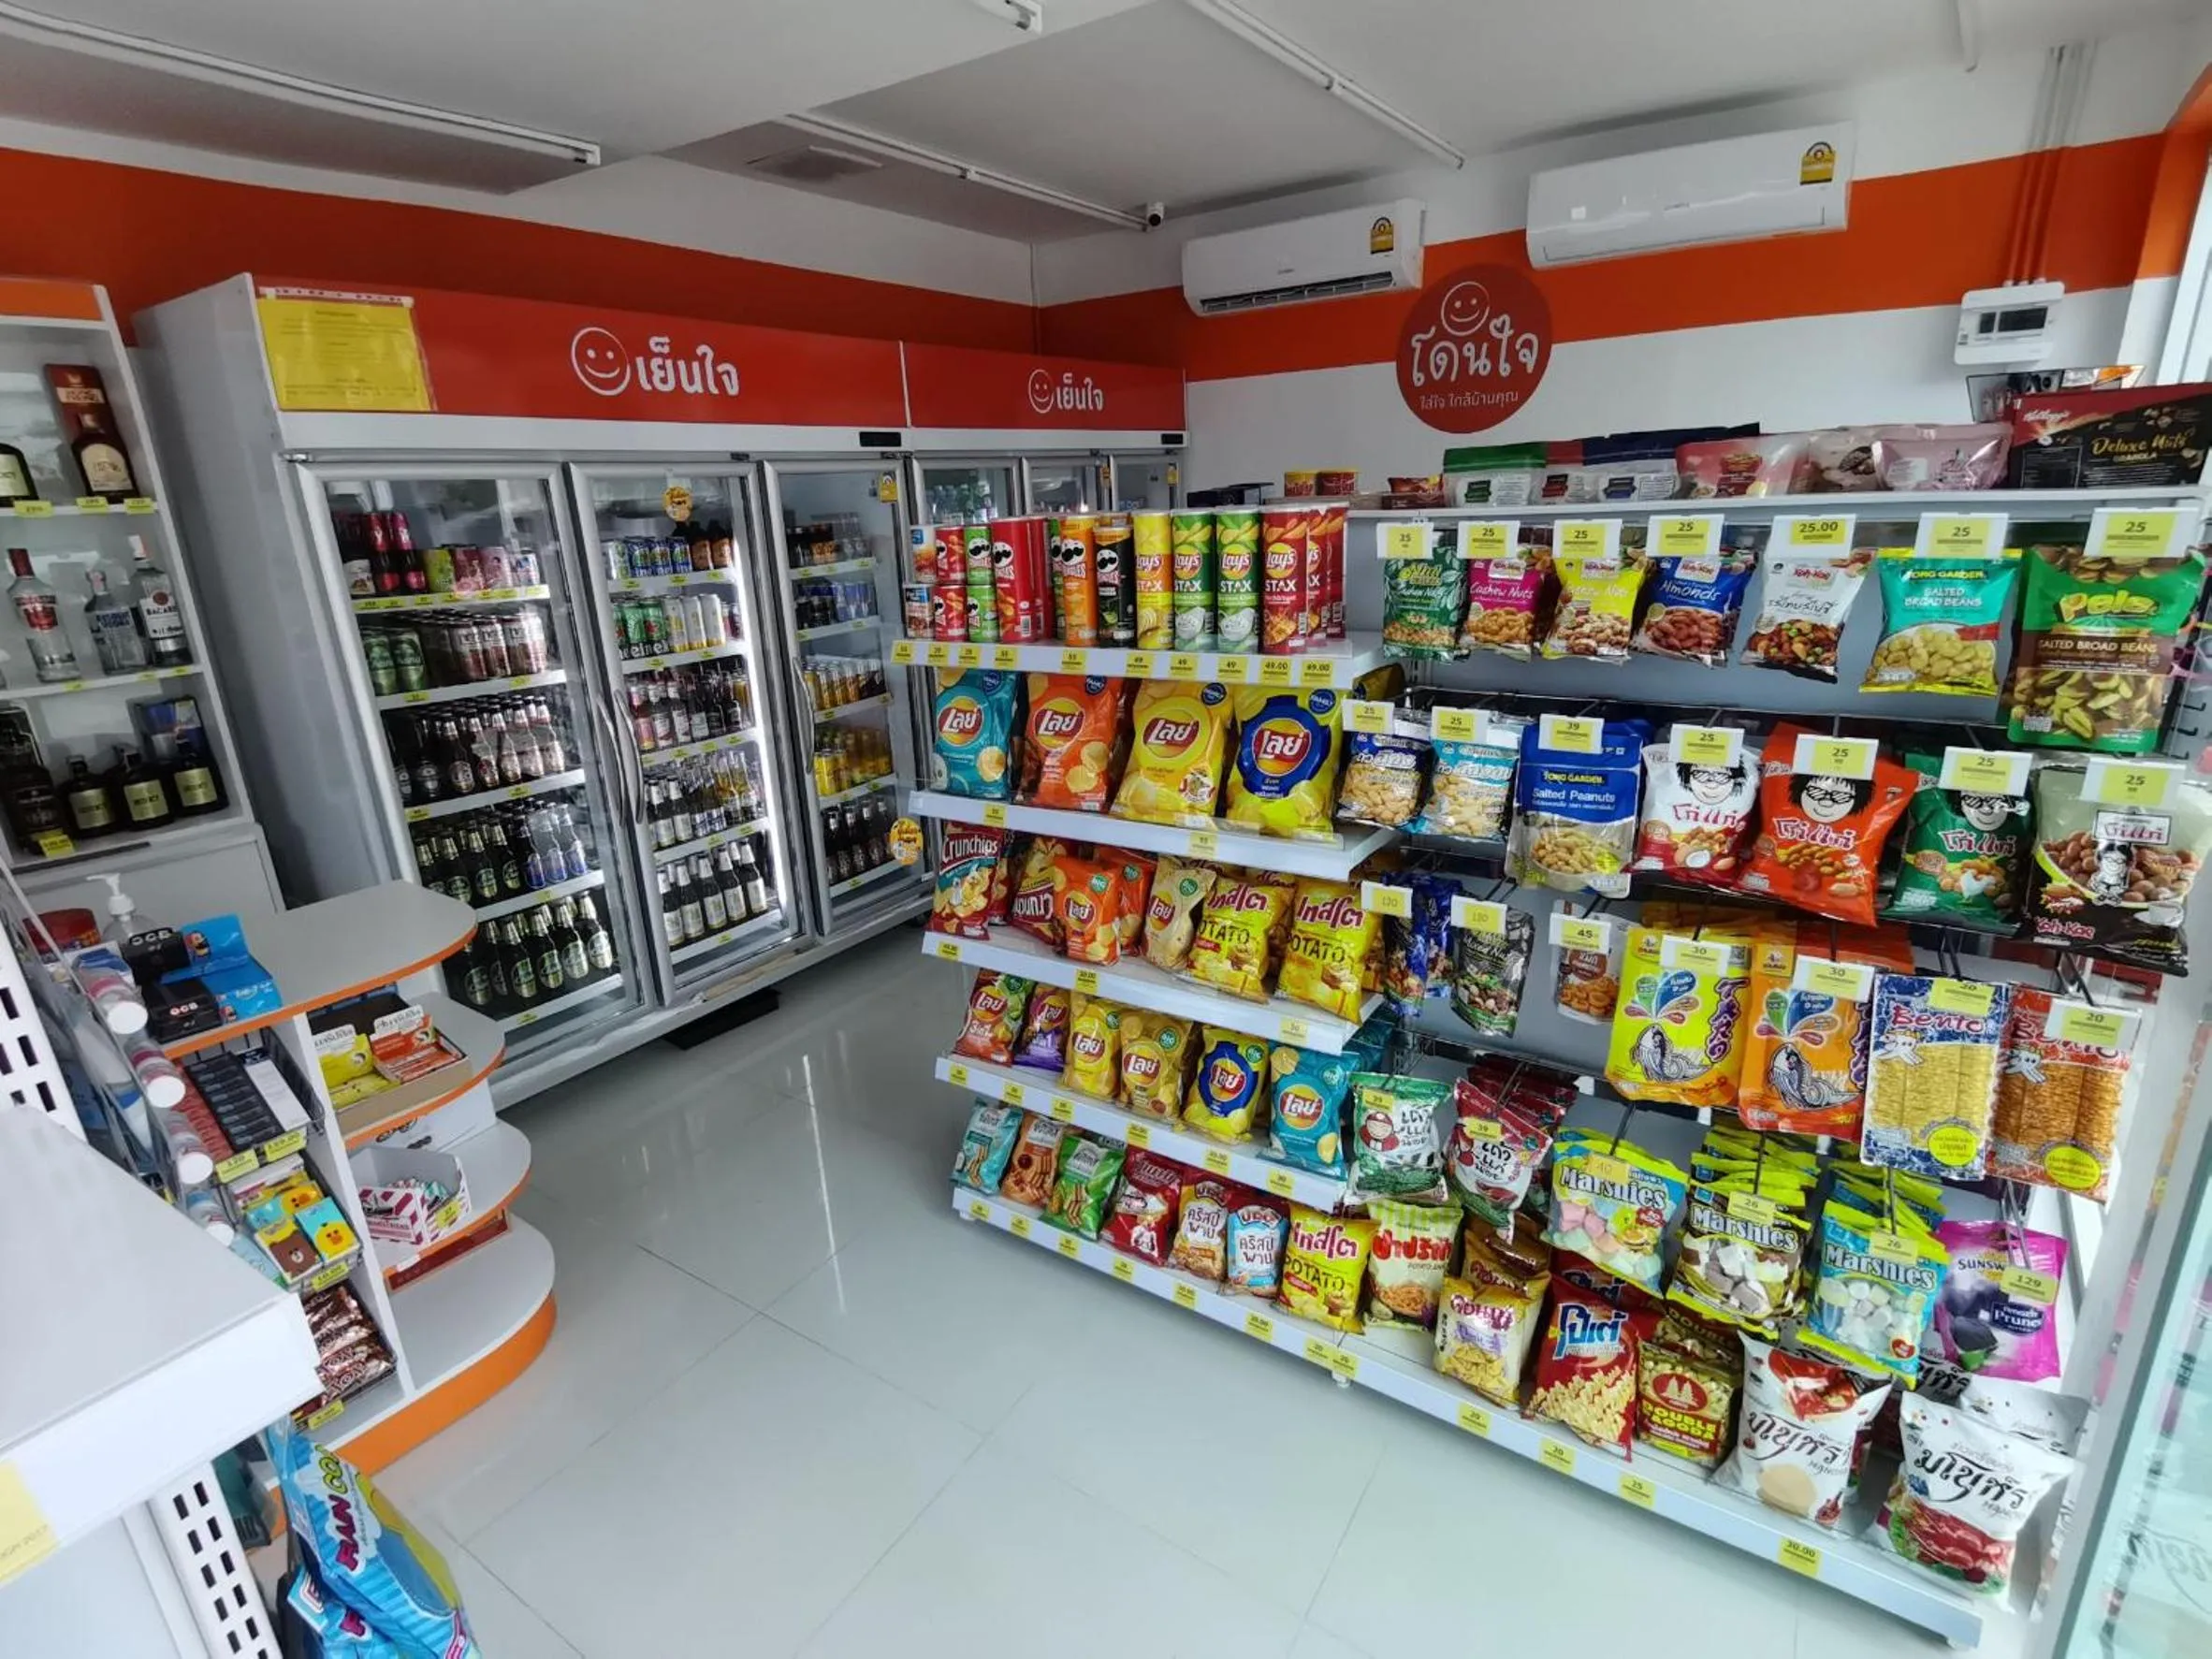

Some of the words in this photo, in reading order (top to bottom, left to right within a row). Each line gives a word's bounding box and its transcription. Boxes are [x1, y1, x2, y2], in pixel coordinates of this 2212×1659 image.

[1411, 313, 1539, 387] โดนใจ
[636, 336, 739, 396] เย็นใจ
[1055, 371, 1103, 411] เย็นใจ
[2090, 435, 2147, 456] Deluxe
[1482, 528, 1495, 537] 25
[1678, 521, 1694, 531] 25
[1798, 521, 1839, 533] 25.00
[1952, 527, 1971, 537] 25
[2124, 521, 2147, 533] 25
[1574, 531, 1588, 539] 25
[1220, 579, 1252, 591] STAX
[1265, 579, 1297, 591] STAX
[1469, 582, 1506, 598] Cashew
[1508, 587, 1534, 600] Nuts
[1661, 579, 1722, 601] Almonds
[1924, 588, 1965, 597] SALTED
[1904, 598, 1943, 607] BROAD
[1944, 598, 1983, 607] BEANS
[2076, 640, 2118, 651] BROAD
[2120, 641, 2158, 653] BEANS
[942, 706, 979, 733] เลย์
[1039, 707, 1080, 735] เลย์
[1146, 719, 1196, 746] เลย์
[1699, 732, 1714, 743] 25
[1259, 728, 1306, 759] เลย์
[1832, 747, 1848, 758] 25
[1976, 756, 1995, 767] 25
[2125, 774, 2146, 786] 25
[1533, 787, 1565, 801] Salted
[1569, 789, 1616, 804] Peanuts
[941, 834, 998, 864] Crunchips
[1198, 921, 1251, 945] OTATO
[1577, 928, 1594, 939] 45
[1289, 934, 1346, 963] OTATO
[1692, 947, 1708, 956] 30
[1828, 967, 1845, 977] 30
[170, 1001, 199, 1016] OCB
[1891, 1005, 1986, 1033] Bento
[2085, 1011, 2104, 1023] 20
[1292, 1222, 1359, 1259] เทสโต
[1957, 1257, 2004, 1272] SUNSW
[2016, 1273, 2042, 1288] 129
[1642, 1398, 1717, 1433] DOUBLE
